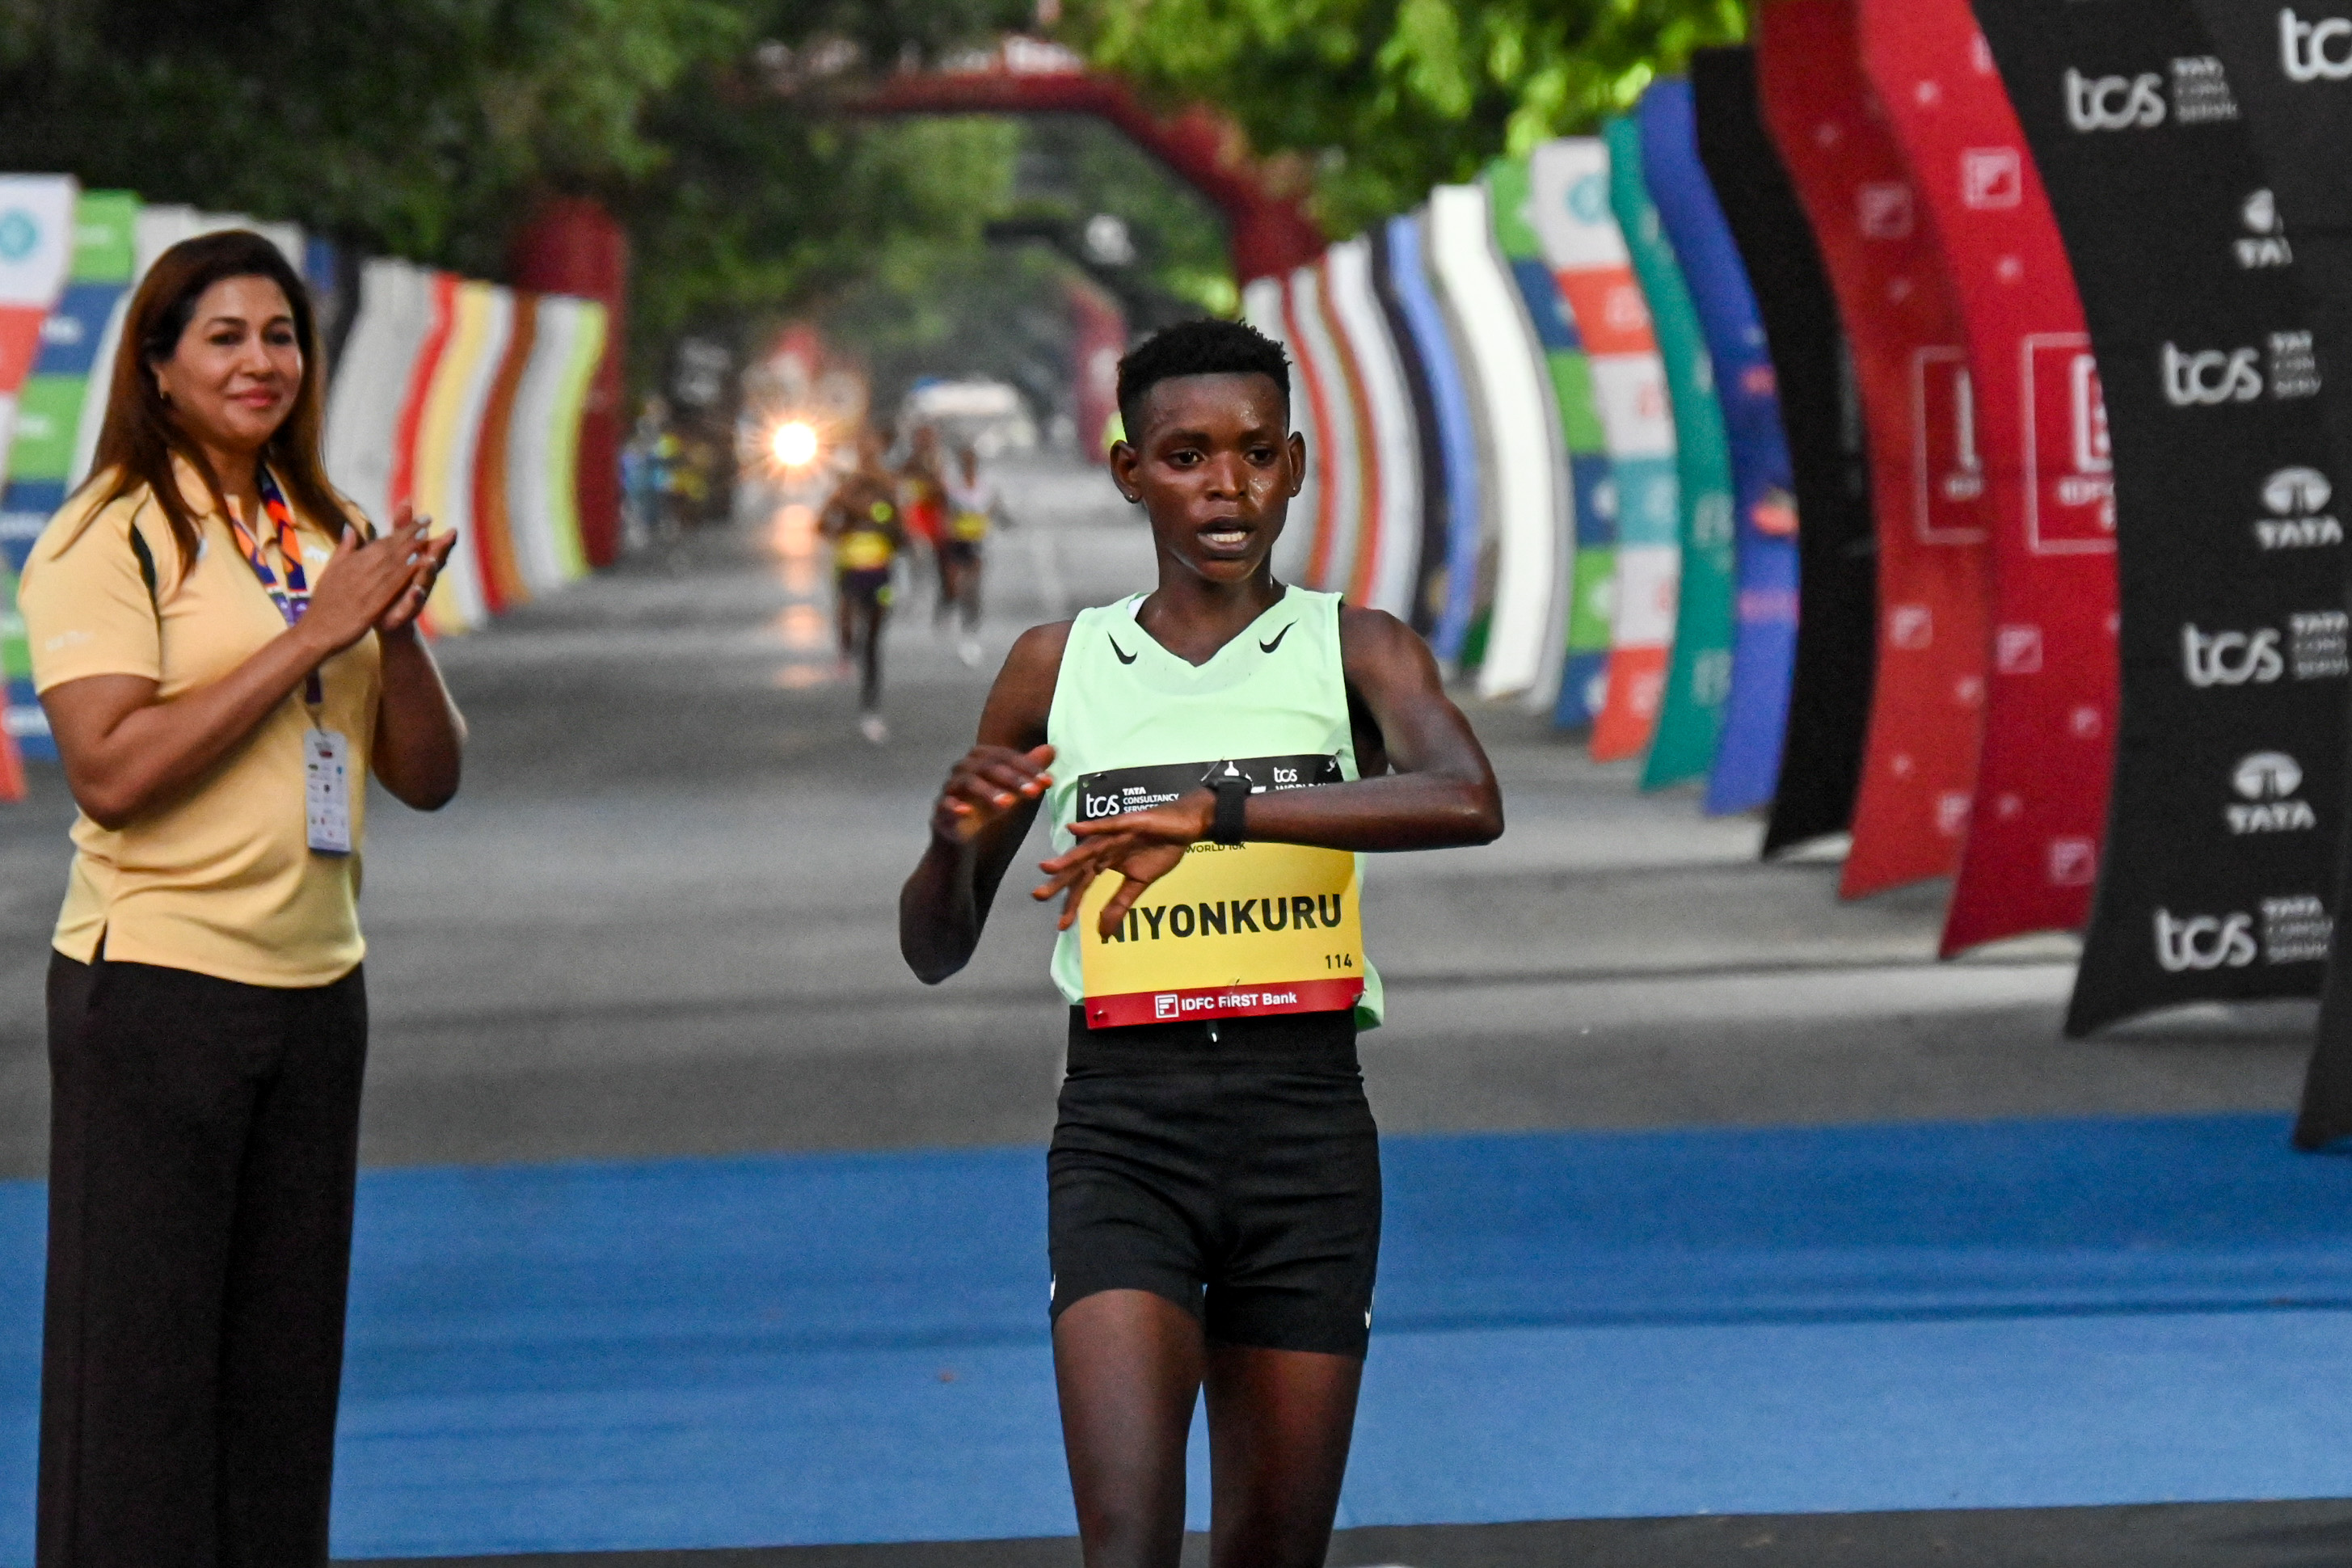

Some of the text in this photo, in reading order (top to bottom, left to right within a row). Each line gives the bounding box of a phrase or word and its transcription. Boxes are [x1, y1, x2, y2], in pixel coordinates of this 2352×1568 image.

[2279, 6, 2352, 82] tc
[2065, 66, 2167, 132] tcs
[2163, 339, 2264, 405] tcs
[2257, 516, 2344, 549] TATA
[2182, 621, 2284, 686] tcs
[1122, 786, 1147, 796] TATA
[1273, 766, 1298, 783] tcs
[1085, 793, 1120, 818] tcs
[1123, 793, 1179, 805] CONSULTANCY
[2228, 801, 2316, 834] TATA
[2155, 908, 2257, 972] tcs
[1325, 953, 1353, 969] 114
[1181, 991, 1297, 1011] IDFC FIRST Bank
